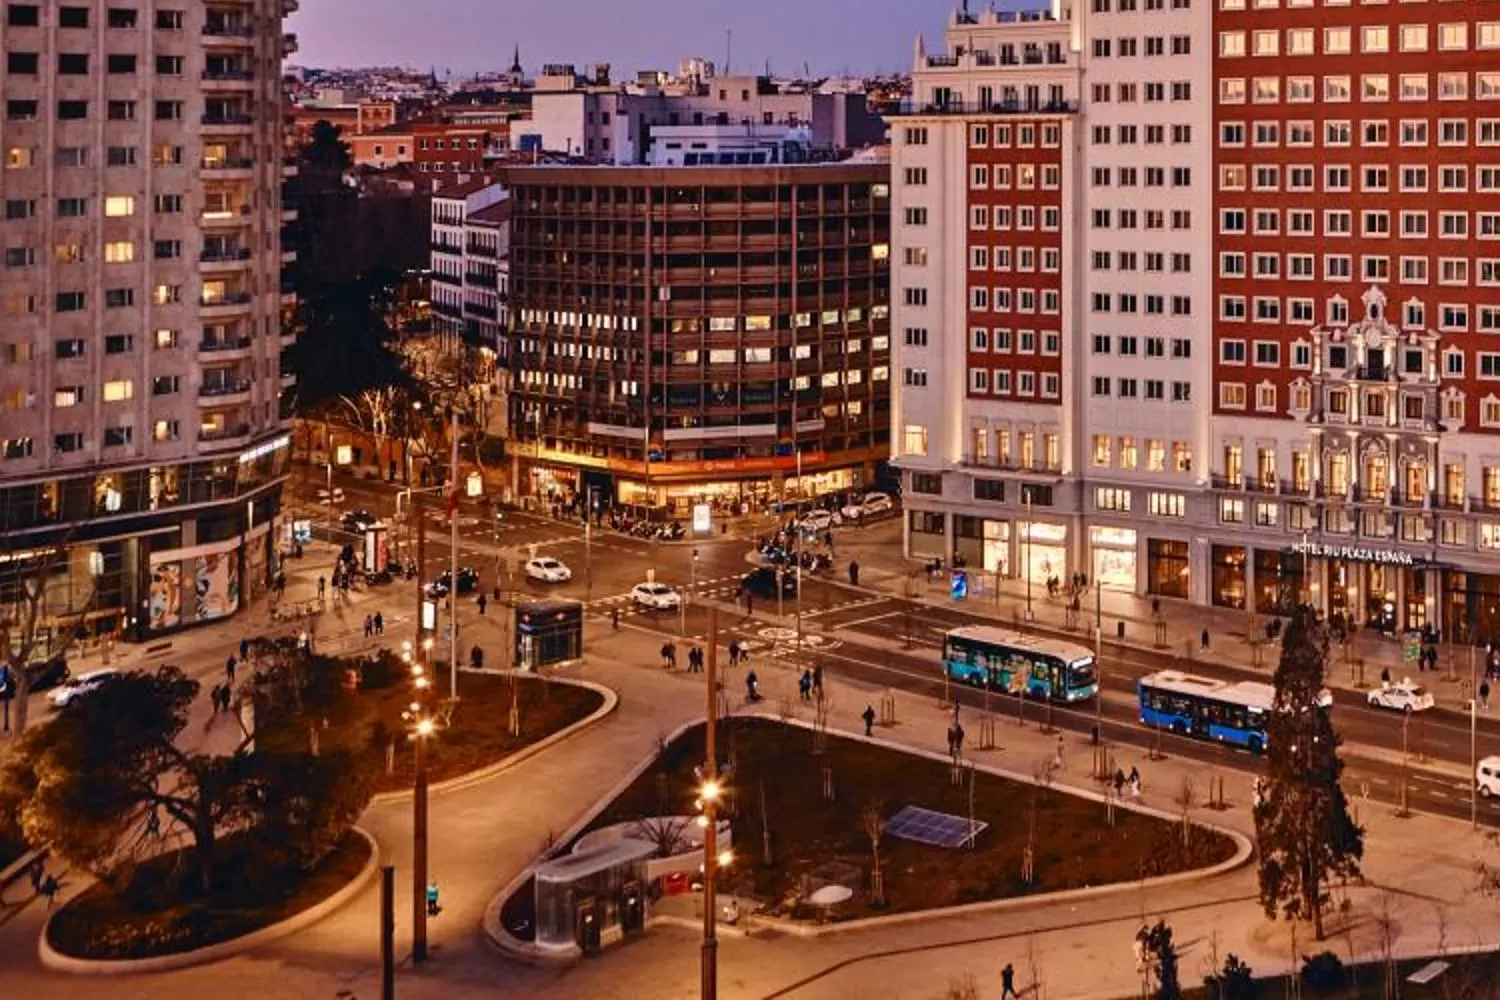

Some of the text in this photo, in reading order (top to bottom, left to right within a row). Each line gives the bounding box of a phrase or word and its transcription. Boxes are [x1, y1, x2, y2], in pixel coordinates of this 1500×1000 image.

[1290, 542, 1323, 555] HOTEL
[1323, 543, 1340, 557] RIU
[1341, 546, 1373, 560] PLAZA
